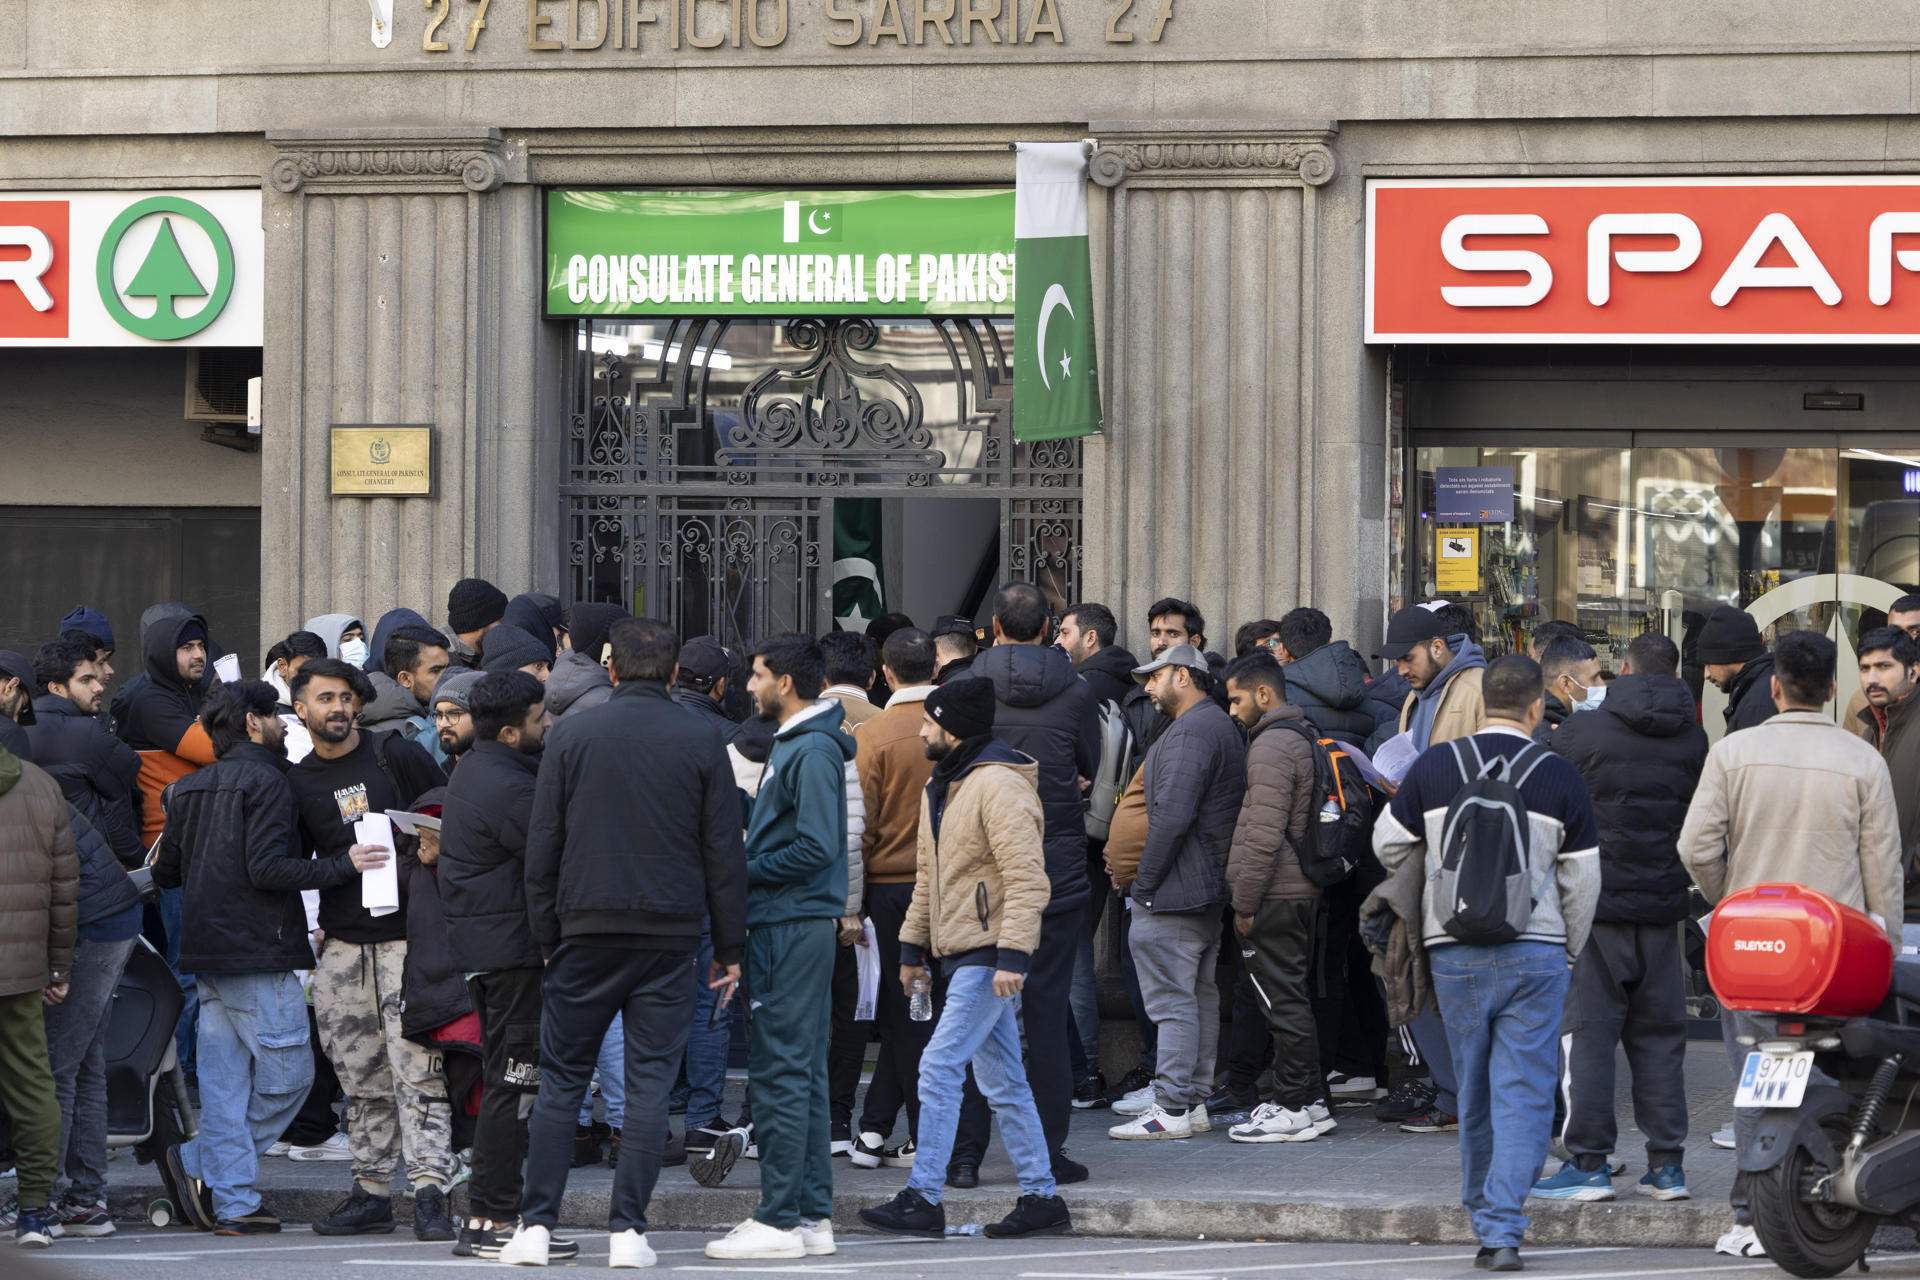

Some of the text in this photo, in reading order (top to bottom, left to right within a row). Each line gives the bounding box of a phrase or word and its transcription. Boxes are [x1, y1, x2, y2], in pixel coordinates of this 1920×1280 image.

[423, 0, 1173, 51] 27 EDIFICIO SARRIA 27
[567, 254, 734, 304] CONSULATE
[741, 253, 868, 303] GENERAL
[875, 252, 912, 303] OF
[333, 782, 367, 800] HAVANA
[1734, 939, 1774, 952] SILENCE
[1759, 1057, 1808, 1079] 9710
